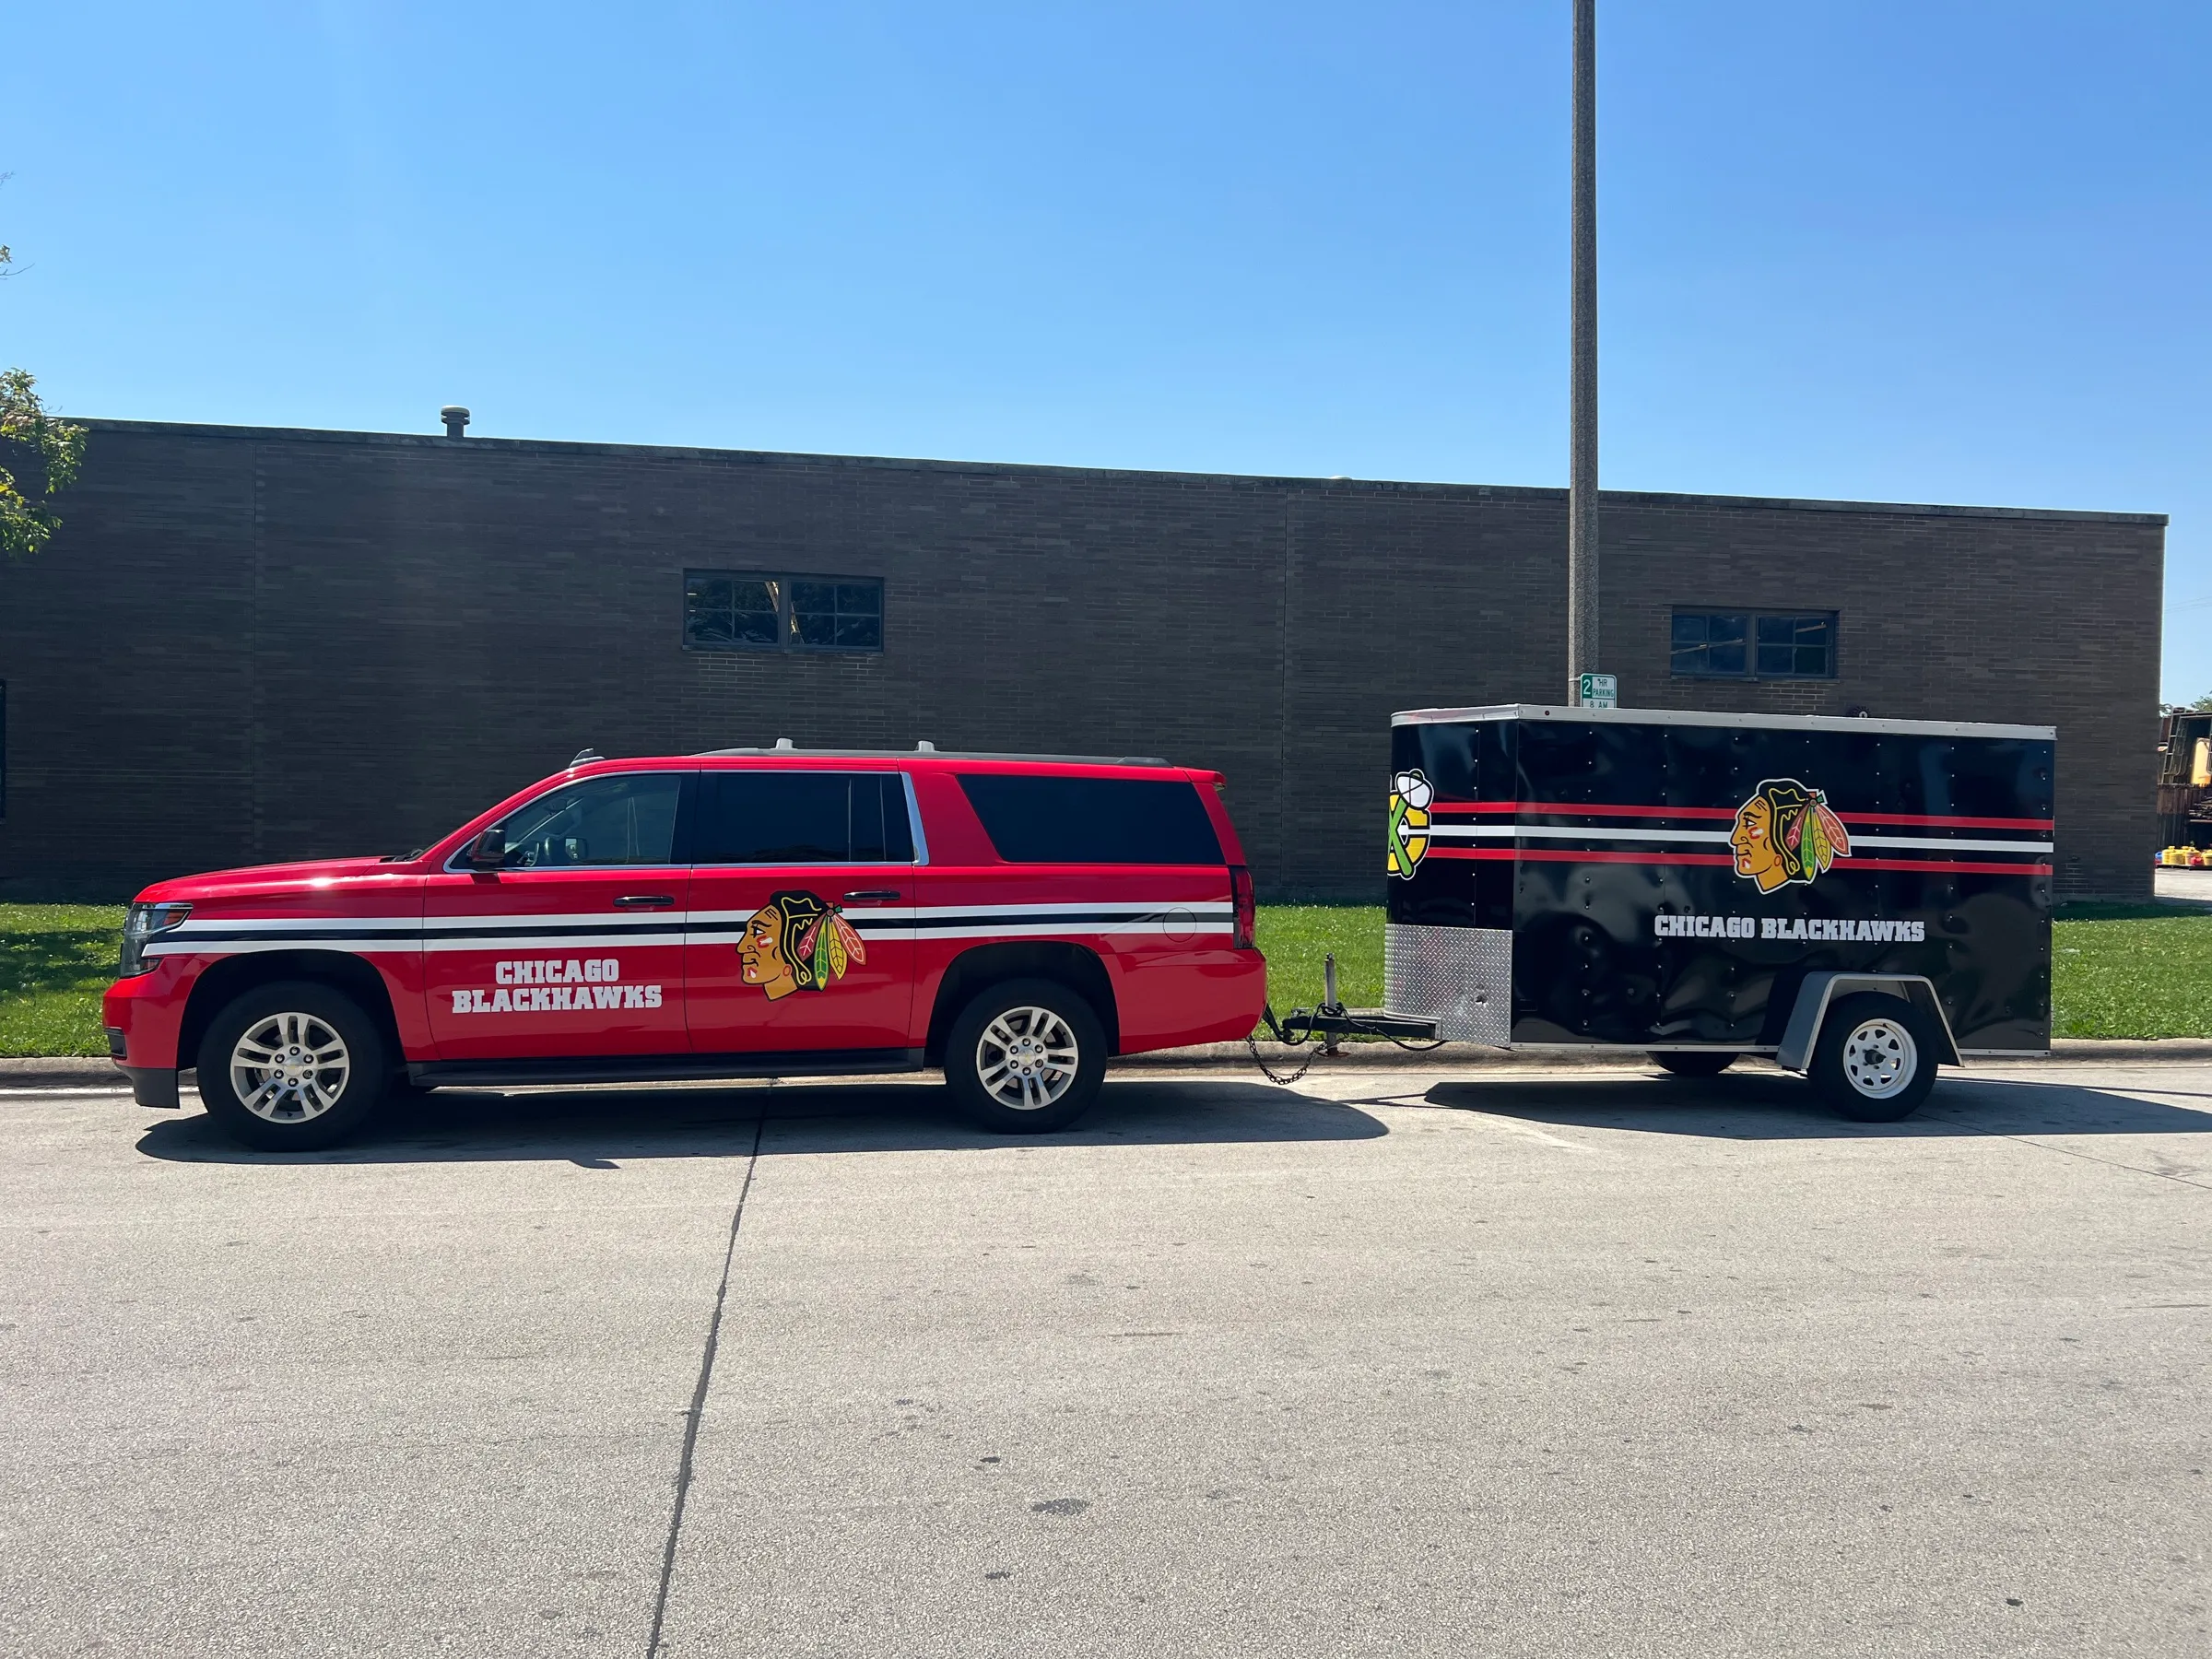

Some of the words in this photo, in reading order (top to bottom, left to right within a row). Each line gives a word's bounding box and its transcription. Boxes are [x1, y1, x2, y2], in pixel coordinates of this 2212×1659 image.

[1583, 679, 1591, 694] 2
[1593, 689, 1614, 697] PARKING
[1654, 914, 1755, 938] CHICAGO
[1760, 918, 1925, 942] BLACKHAWKS
[495, 959, 619, 984] CHICAGO
[452, 984, 663, 1014] BLACKHAWKS
